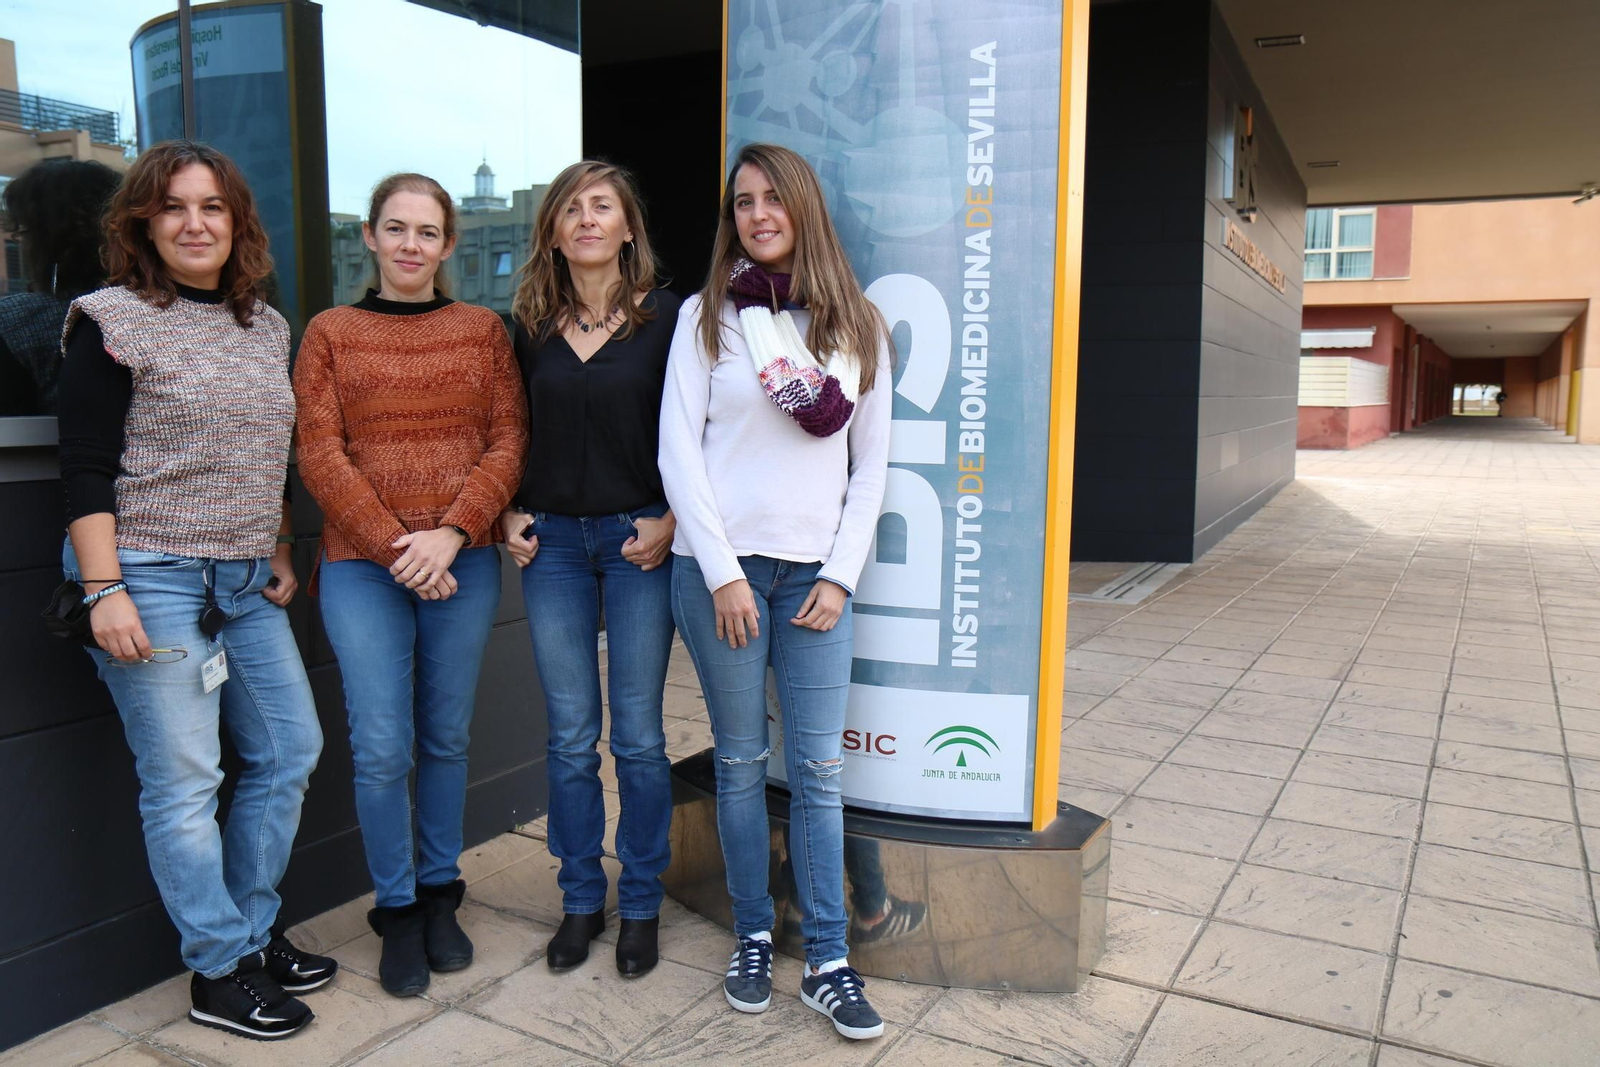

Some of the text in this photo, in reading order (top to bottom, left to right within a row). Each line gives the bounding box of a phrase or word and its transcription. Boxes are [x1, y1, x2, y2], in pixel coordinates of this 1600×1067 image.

[951, 41, 997, 668] INSTITUTO DE BIOMEDICINA DE SEVILLA
[921, 768, 945, 779] JUNTA
[948, 771, 957, 780] DE
